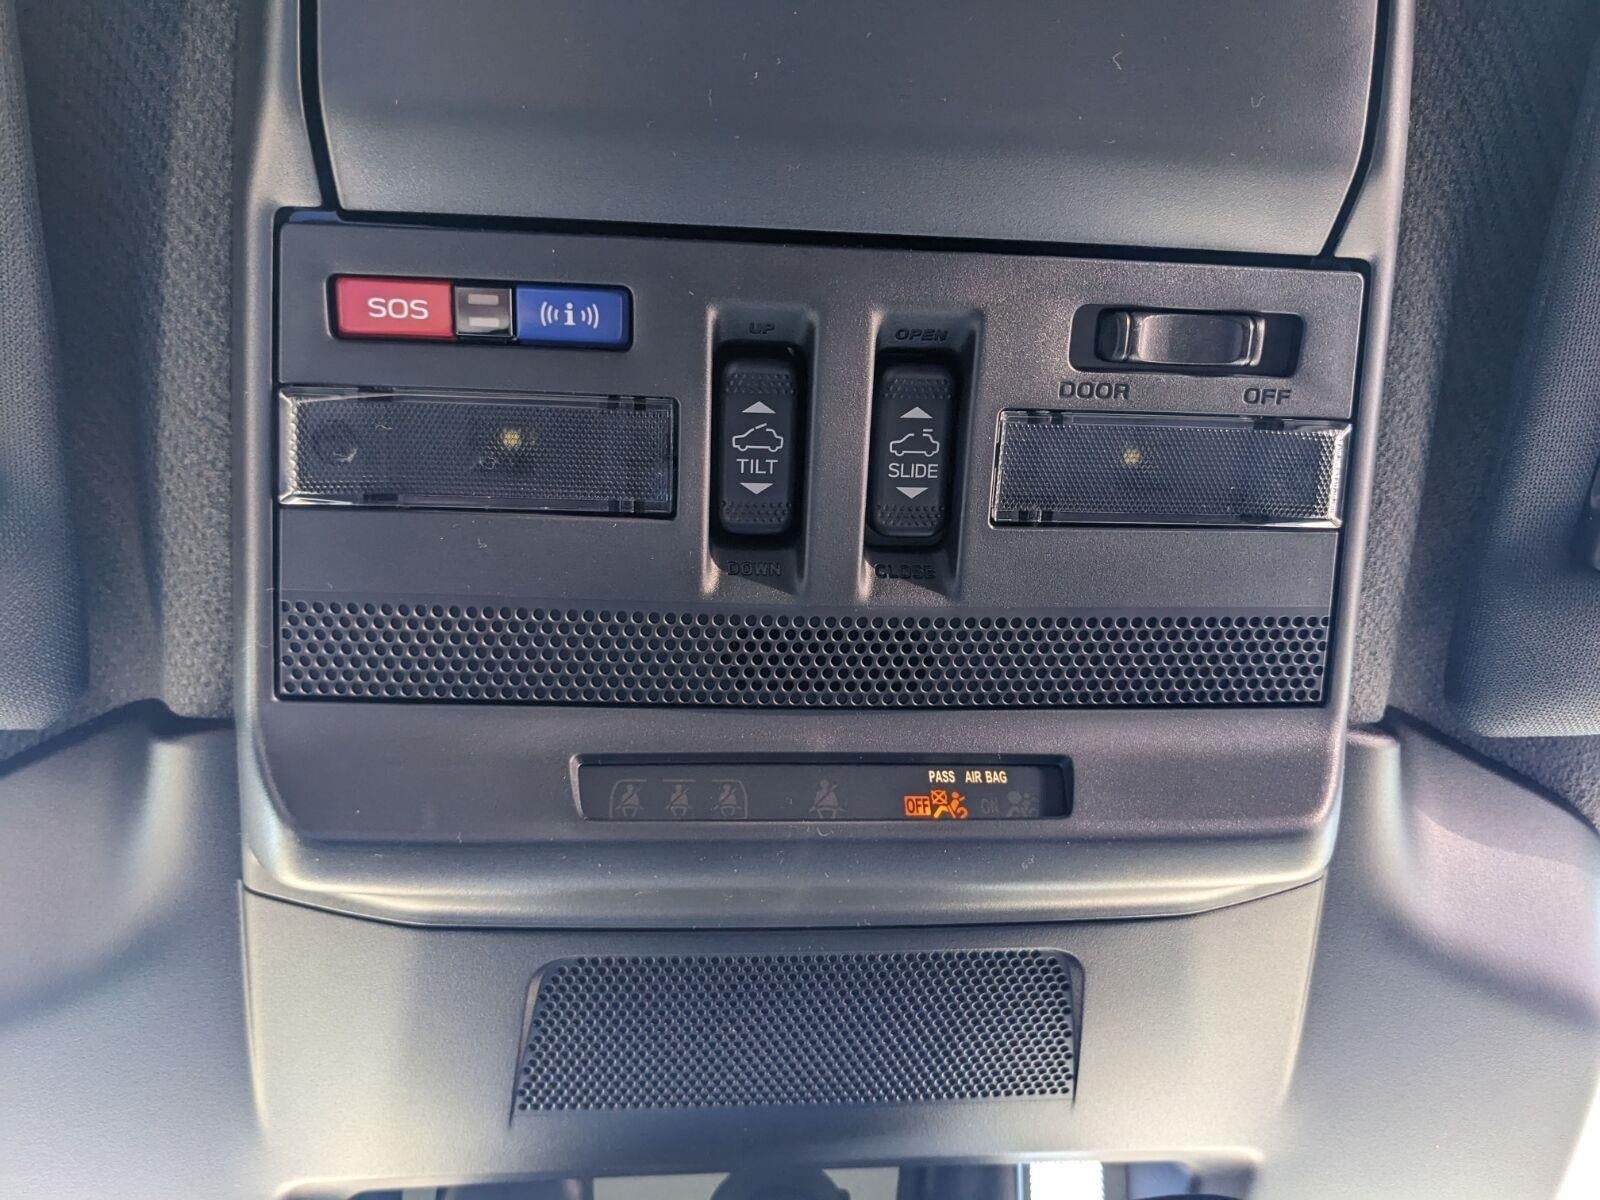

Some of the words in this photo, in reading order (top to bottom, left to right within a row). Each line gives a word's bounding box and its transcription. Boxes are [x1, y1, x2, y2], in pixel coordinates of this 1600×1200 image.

[367, 297, 430, 320] SOS
[749, 322, 775, 335] UP
[895, 328, 948, 342] OPEN
[1058, 381, 1131, 400] DOOR
[1242, 387, 1292, 405] OFF
[736, 458, 779, 475] TILT
[888, 463, 939, 479] SLIDE
[727, 561, 782, 576] DOWN
[875, 563, 937, 580] CLOSE
[928, 770, 956, 784] PASS
[965, 770, 983, 784] AIR
[985, 770, 1008, 784] BAG
[906, 799, 930, 814] OFF
[980, 798, 1000, 815] ON
